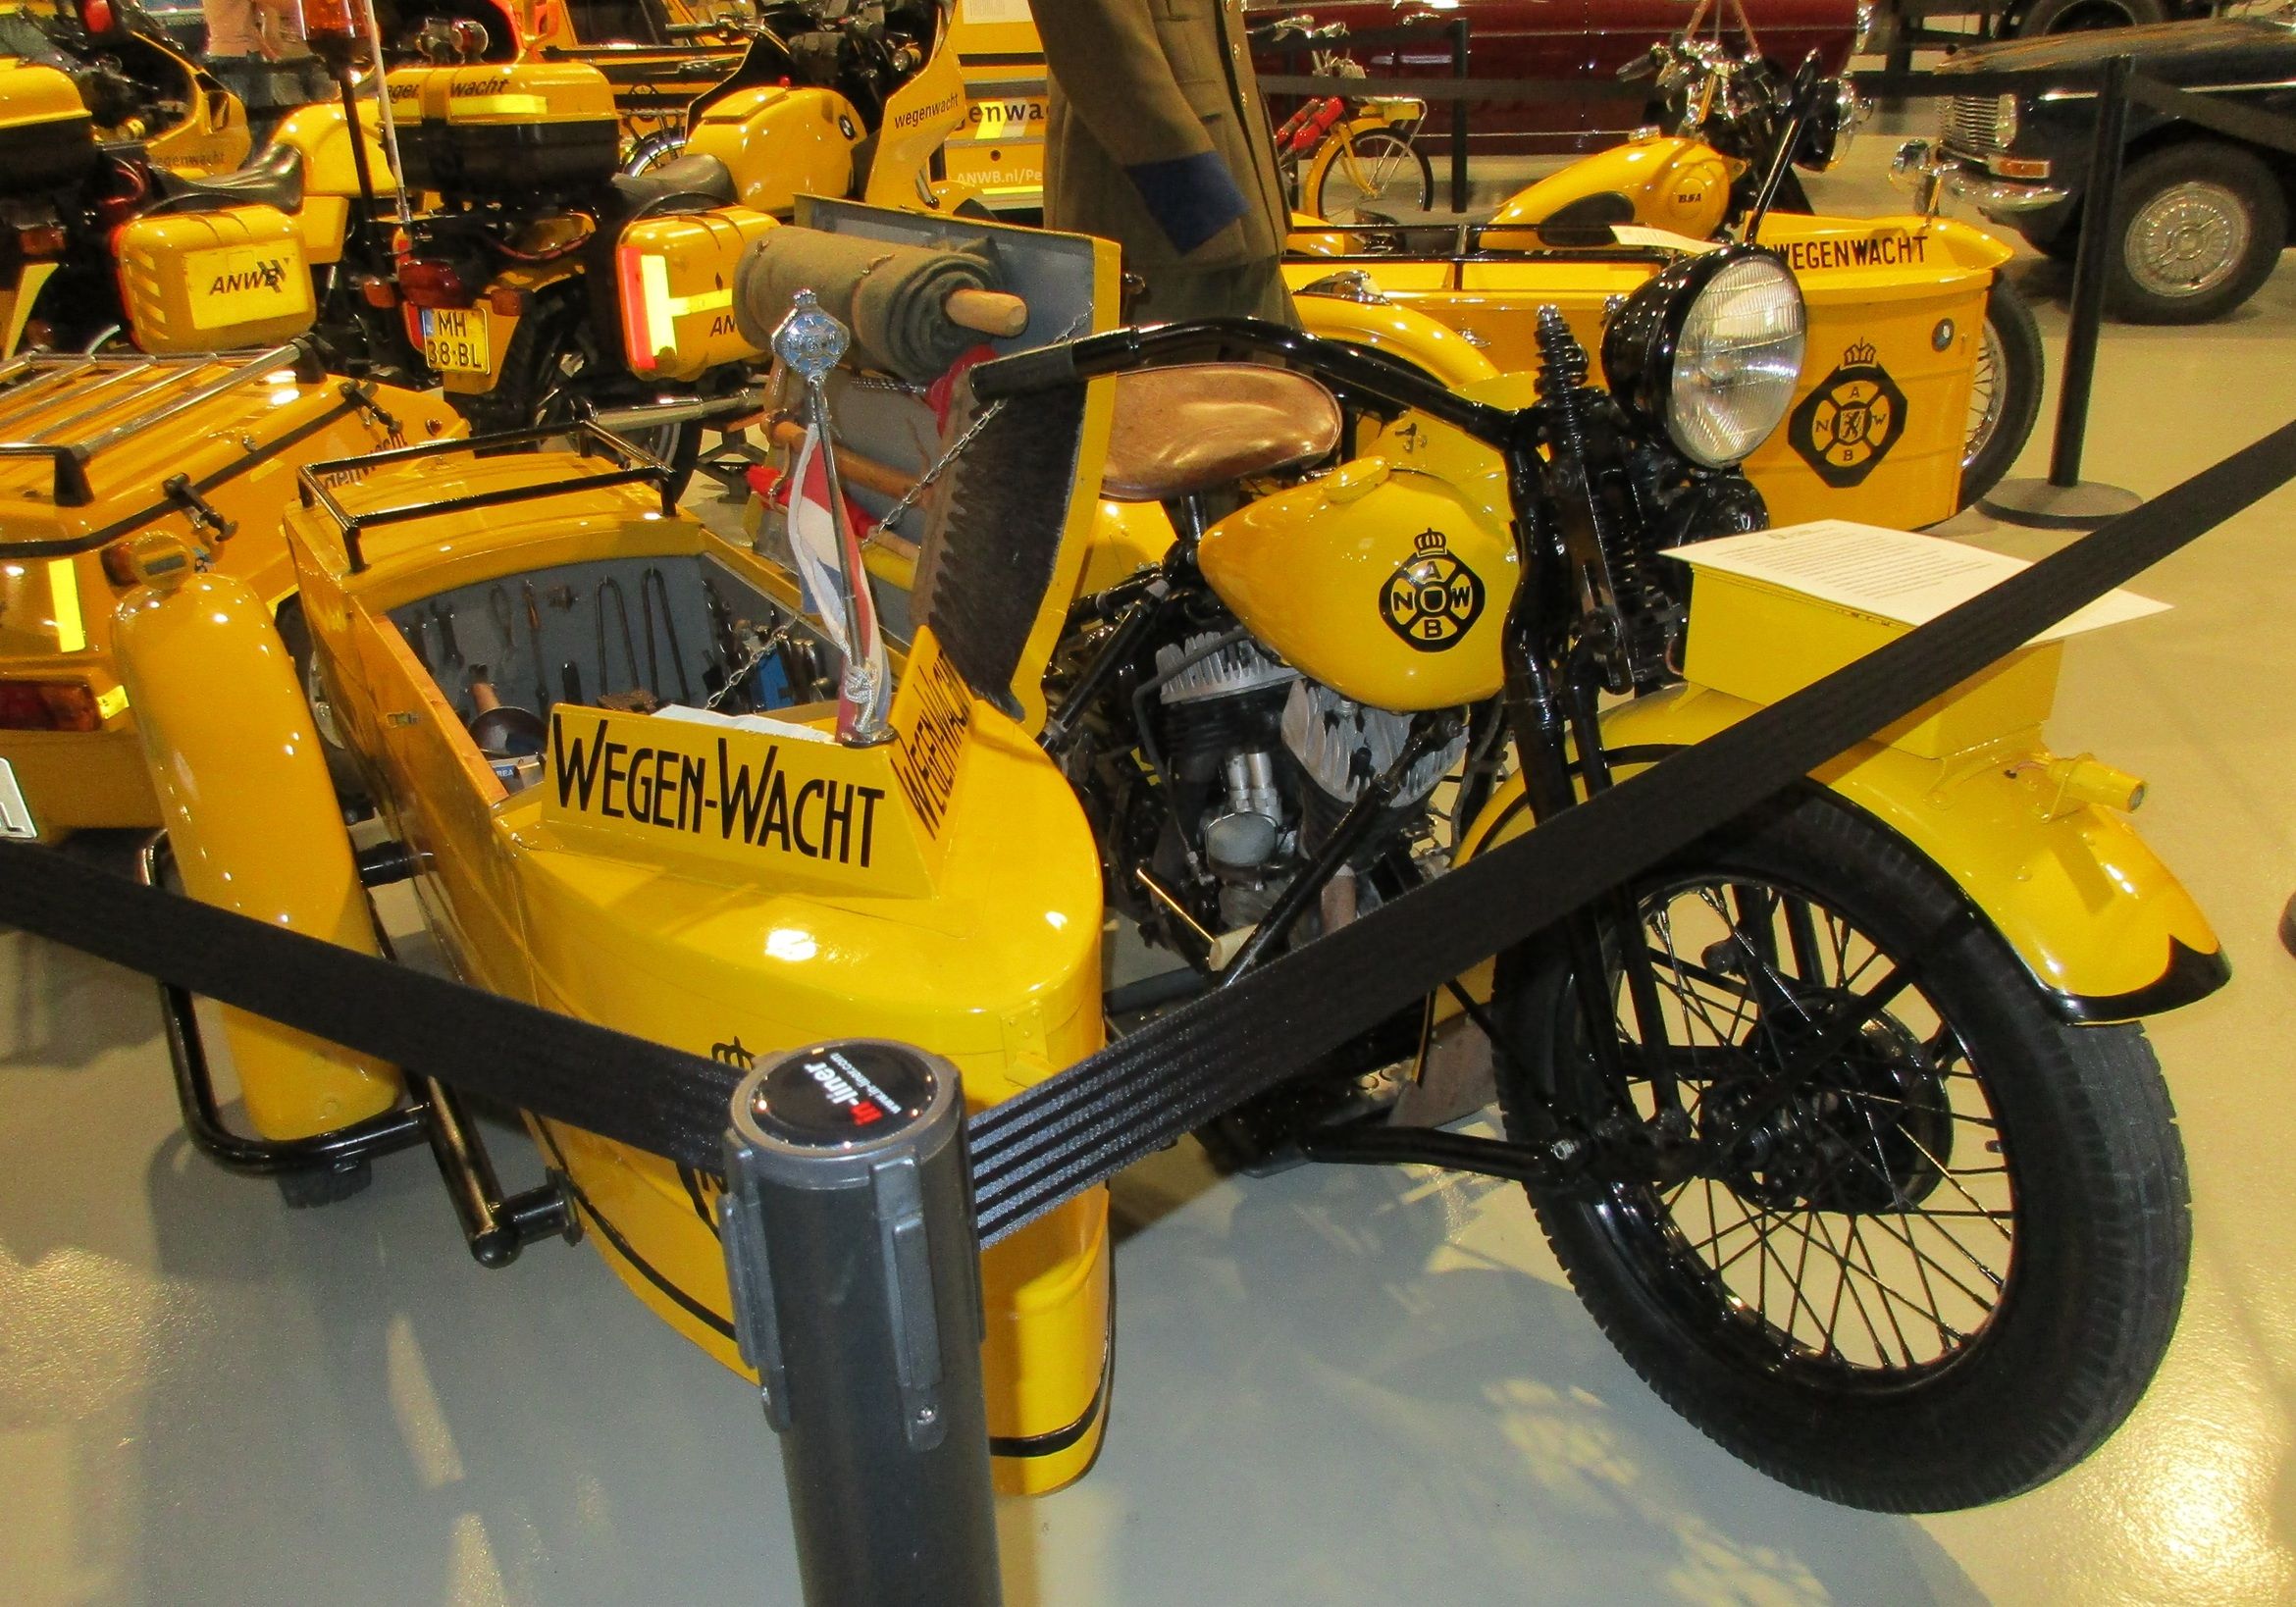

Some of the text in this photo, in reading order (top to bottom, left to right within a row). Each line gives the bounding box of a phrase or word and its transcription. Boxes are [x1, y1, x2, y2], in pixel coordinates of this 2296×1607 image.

[449, 76, 509, 97] wacht
[894, 93, 959, 129] wegenwacht
[439, 311, 467, 337] MH
[553, 713, 885, 867] WEGEN-WACHT
